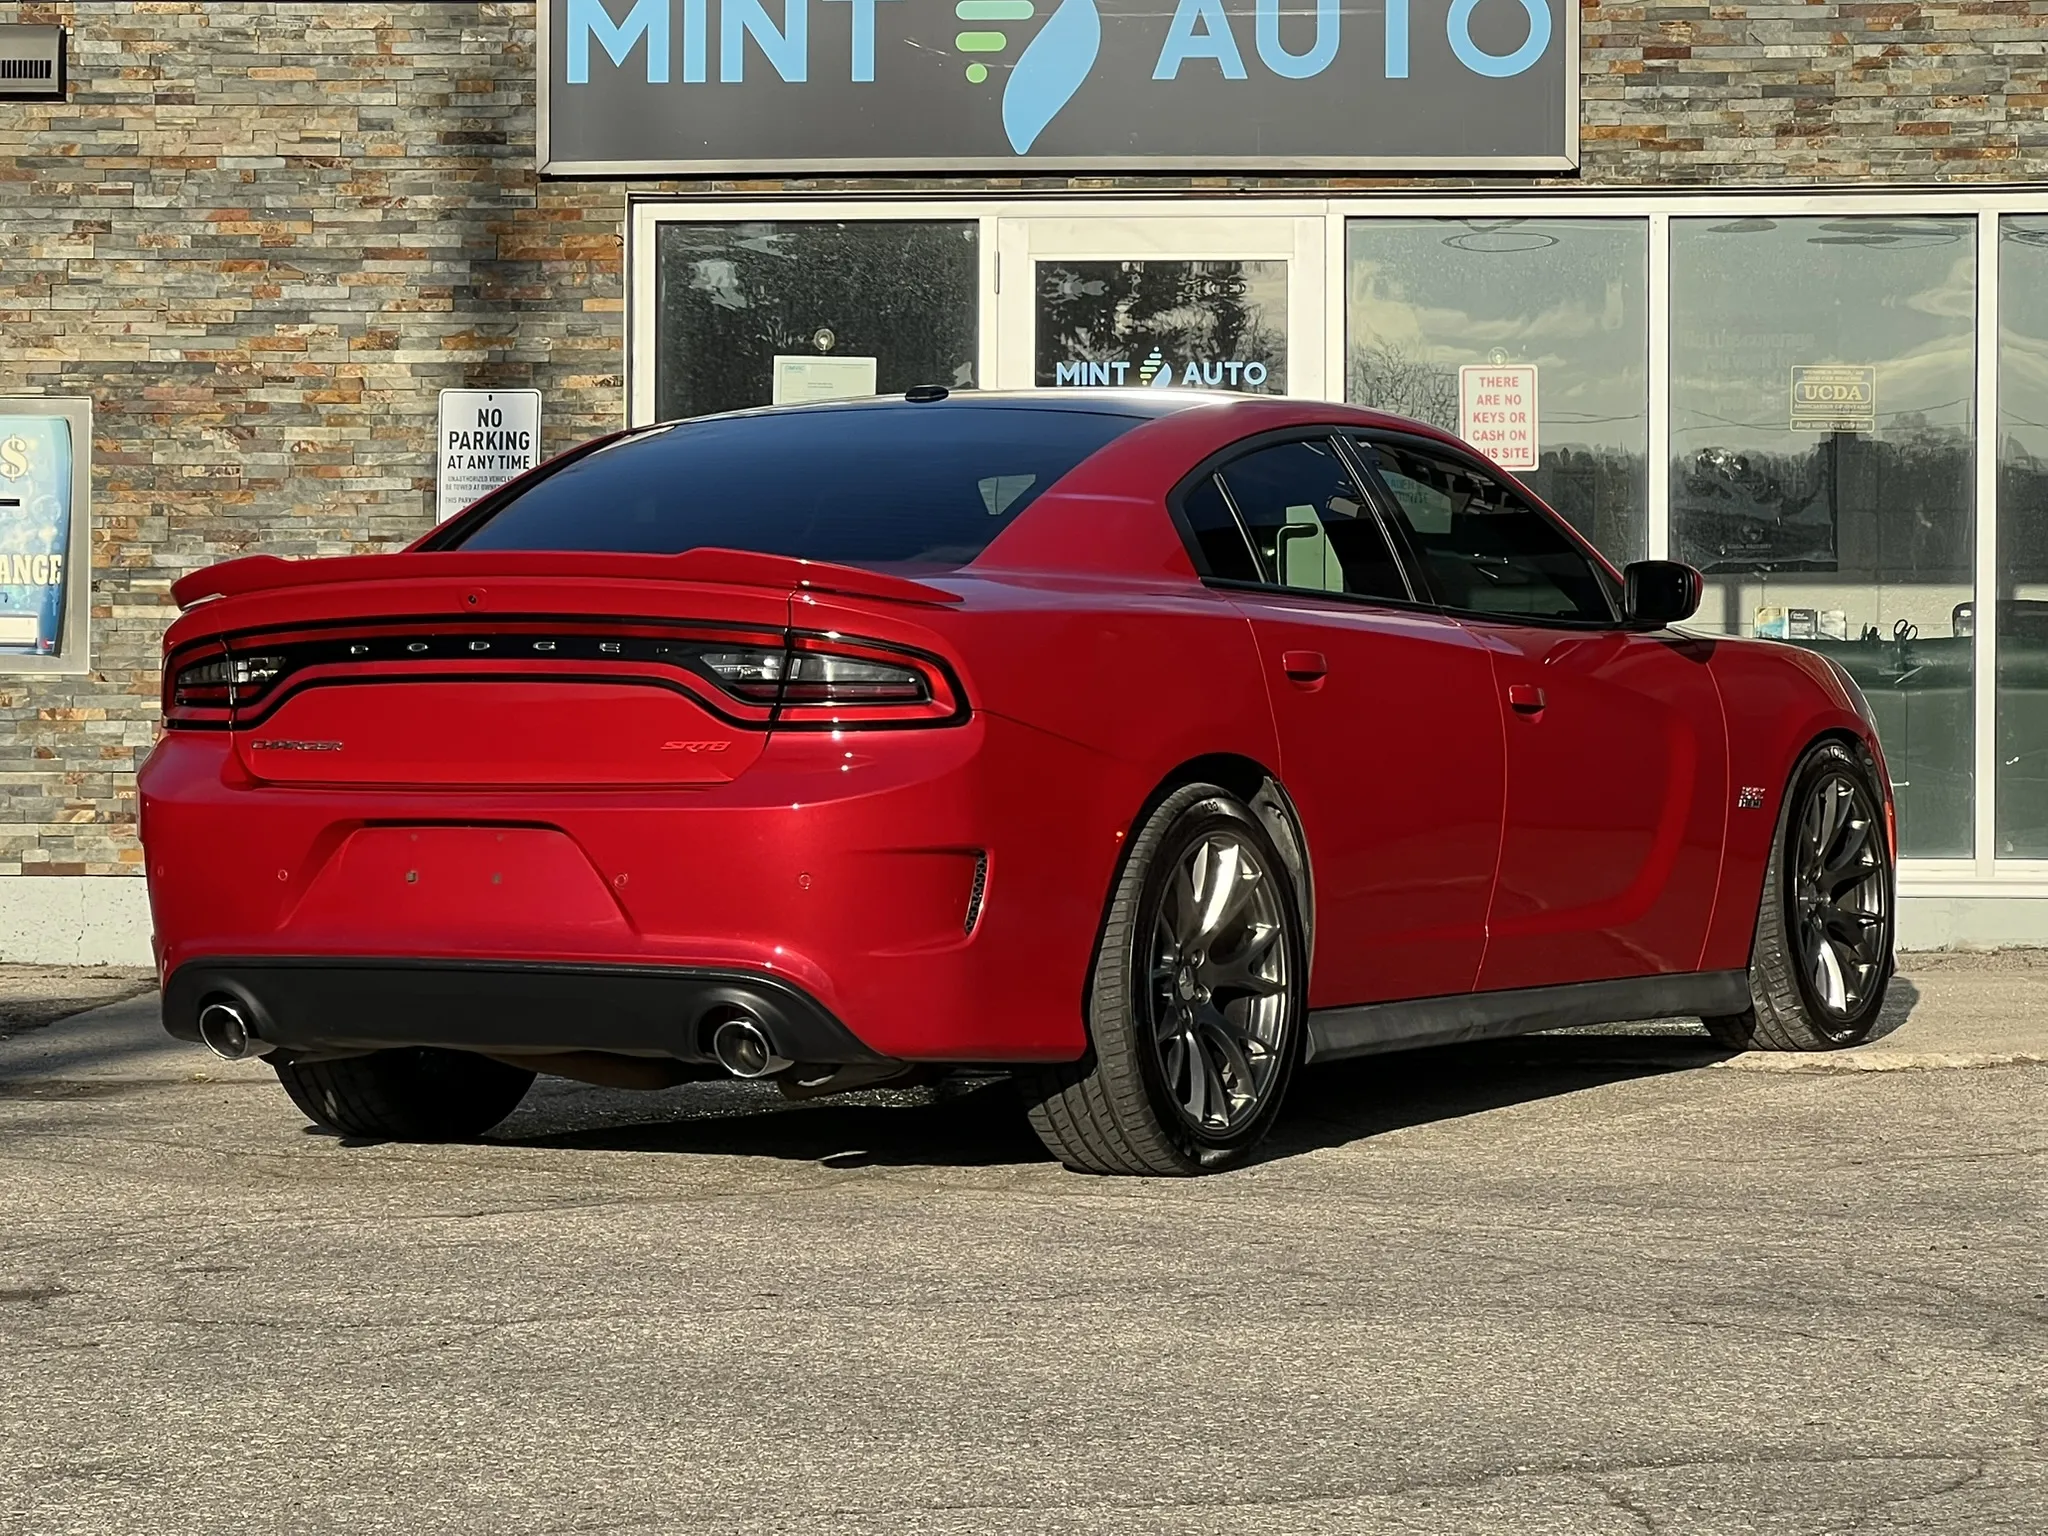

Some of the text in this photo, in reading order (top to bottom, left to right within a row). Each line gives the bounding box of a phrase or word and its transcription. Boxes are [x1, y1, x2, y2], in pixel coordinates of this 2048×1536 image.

[567, 0, 1553, 83] MINT AUTO
[1056, 361, 1267, 386] MINT AUTO
[1479, 376, 1519, 388] THERE
[1804, 385, 1863, 401] UCDA
[1476, 394, 1522, 406] ARE NO
[477, 408, 503, 428] NO
[1473, 412, 1527, 423] KEYS OR
[449, 431, 530, 450] PARKING
[1472, 430, 1527, 441] CASH ON
[1479, 448, 1529, 458] HIS SITE
[447, 455, 530, 470] AT ANY TIME
[351, 641, 621, 655] DODGE
[252, 740, 343, 752] CHARGER
[660, 741, 732, 753] SRT8
